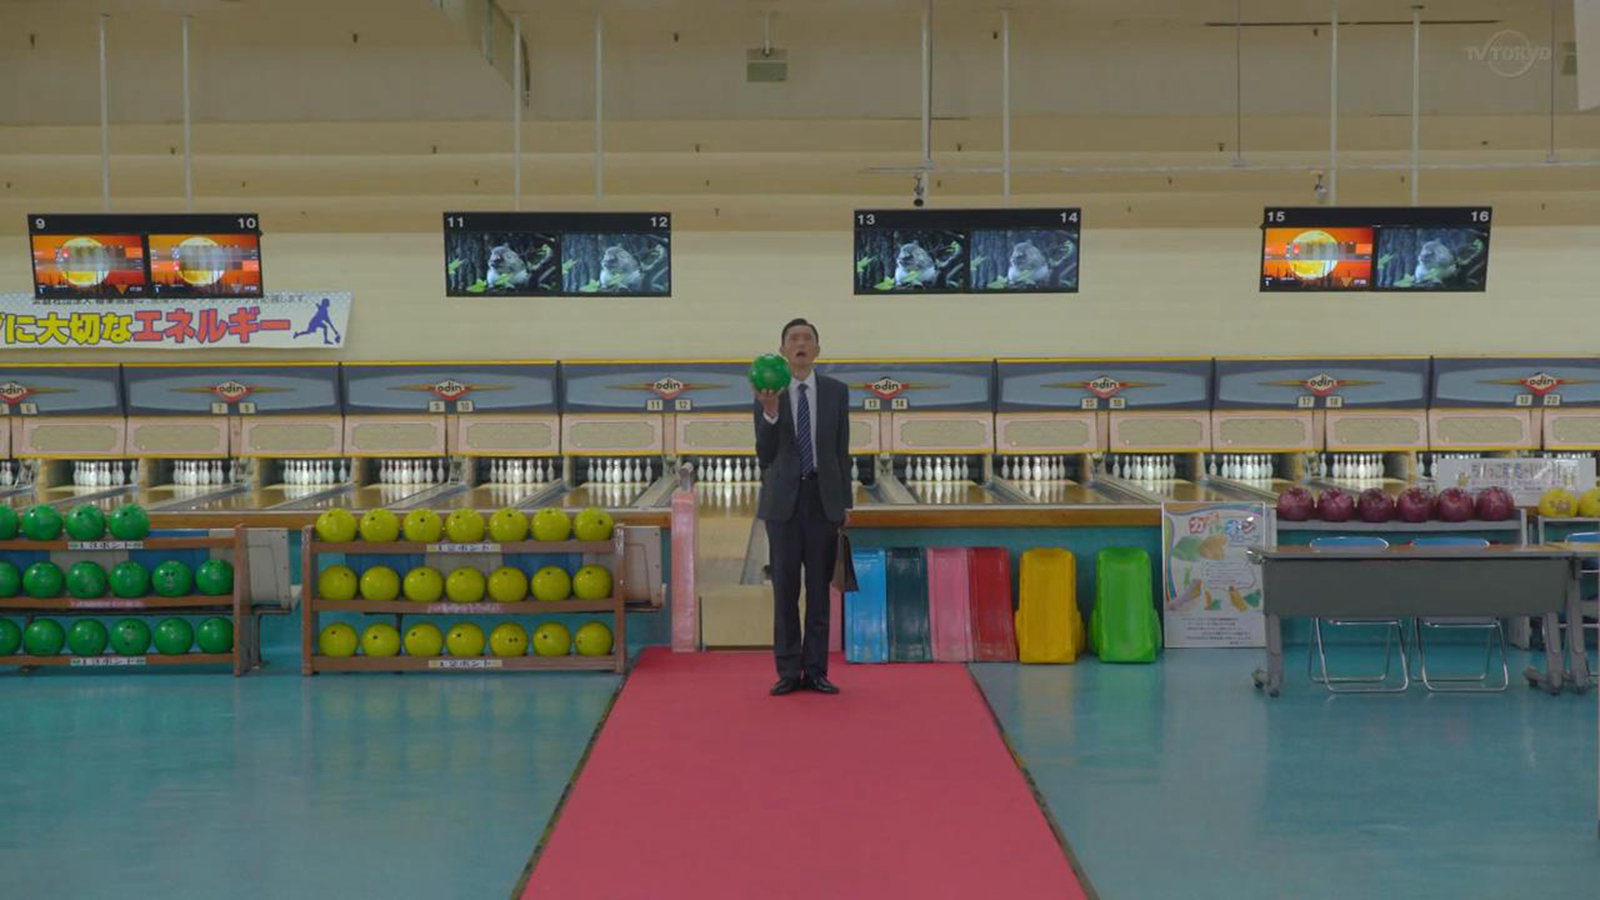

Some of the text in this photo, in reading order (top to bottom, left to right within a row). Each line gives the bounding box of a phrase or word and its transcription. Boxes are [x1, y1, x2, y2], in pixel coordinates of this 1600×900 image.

[650, 217, 668, 227] 12
[857, 214, 876, 225] 13
[1060, 212, 1078, 223] 14
[1267, 211, 1286, 222] 15
[1471, 211, 1489, 222] 16
[35, 218, 46, 229] 9
[237, 218, 256, 229] 10
[447, 217, 464, 228] 11
[0, 306, 290, 344] に大切なエネルギー
[656, 379, 681, 390] odin
[874, 380, 899, 391] odin
[1092, 378, 1119, 389] odin
[1310, 375, 1335, 387] odin
[1530, 375, 1554, 386] odin
[219, 382, 245, 393] odin
[437, 381, 461, 392] odin
